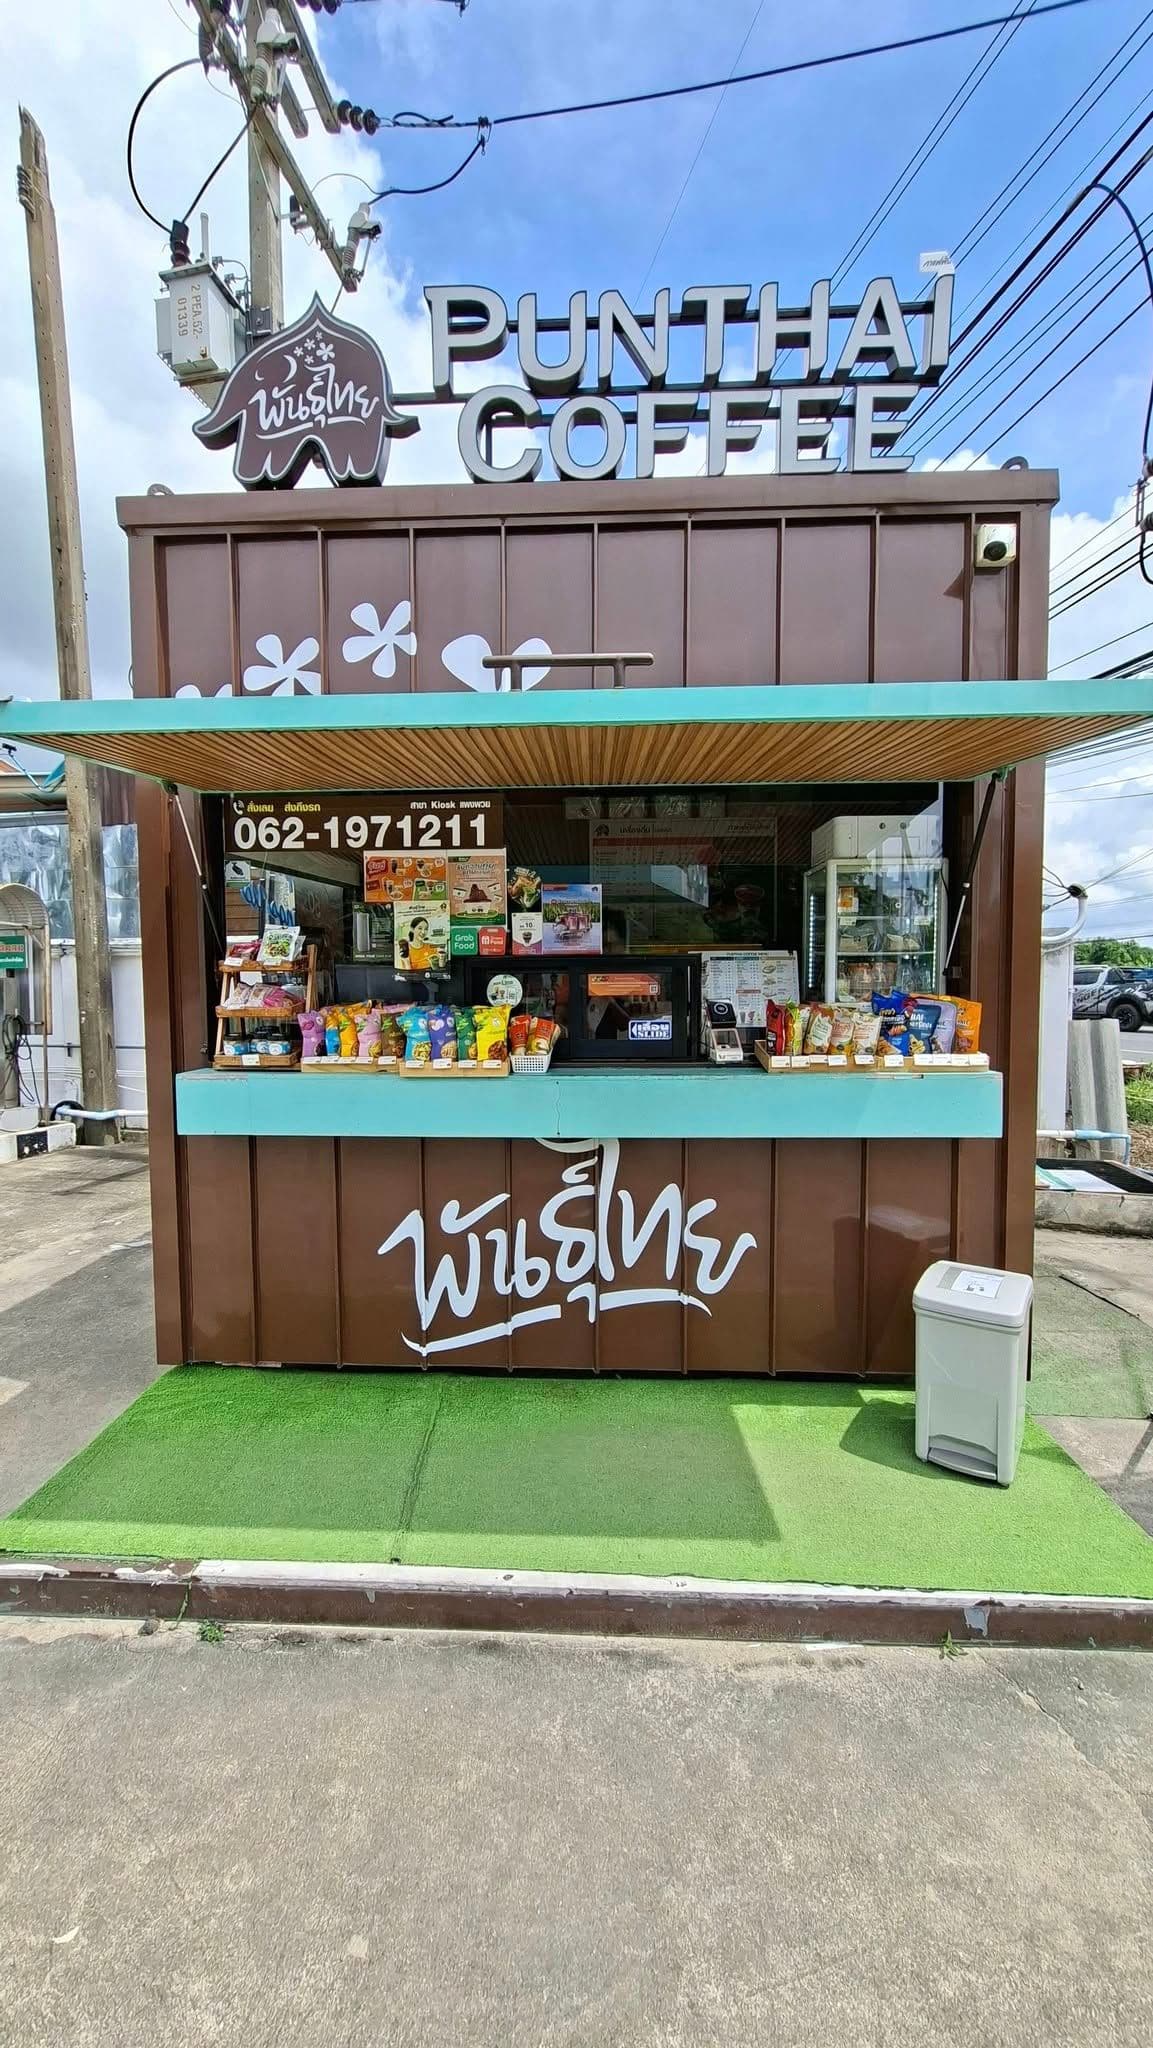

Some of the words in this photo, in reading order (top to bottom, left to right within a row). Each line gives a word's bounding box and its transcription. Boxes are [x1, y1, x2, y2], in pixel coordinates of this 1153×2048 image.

[177, 297, 189, 337] 01339
[423, 273, 956, 397] PUNTHAI
[248, 362, 380, 430] พันธุ์ไทย
[458, 383, 920, 483] COFFEE
[410, 801, 428, 810] สาขา
[431, 800, 456, 809] Kiosk
[233, 813, 486, 850] 062-1971211
[454, 942, 475, 950] Food
[455, 934, 474, 942] Grab
[638, 1020, 669, 1031] เลื่อน
[377, 1138, 758, 1333] พันธุ์ไทย
